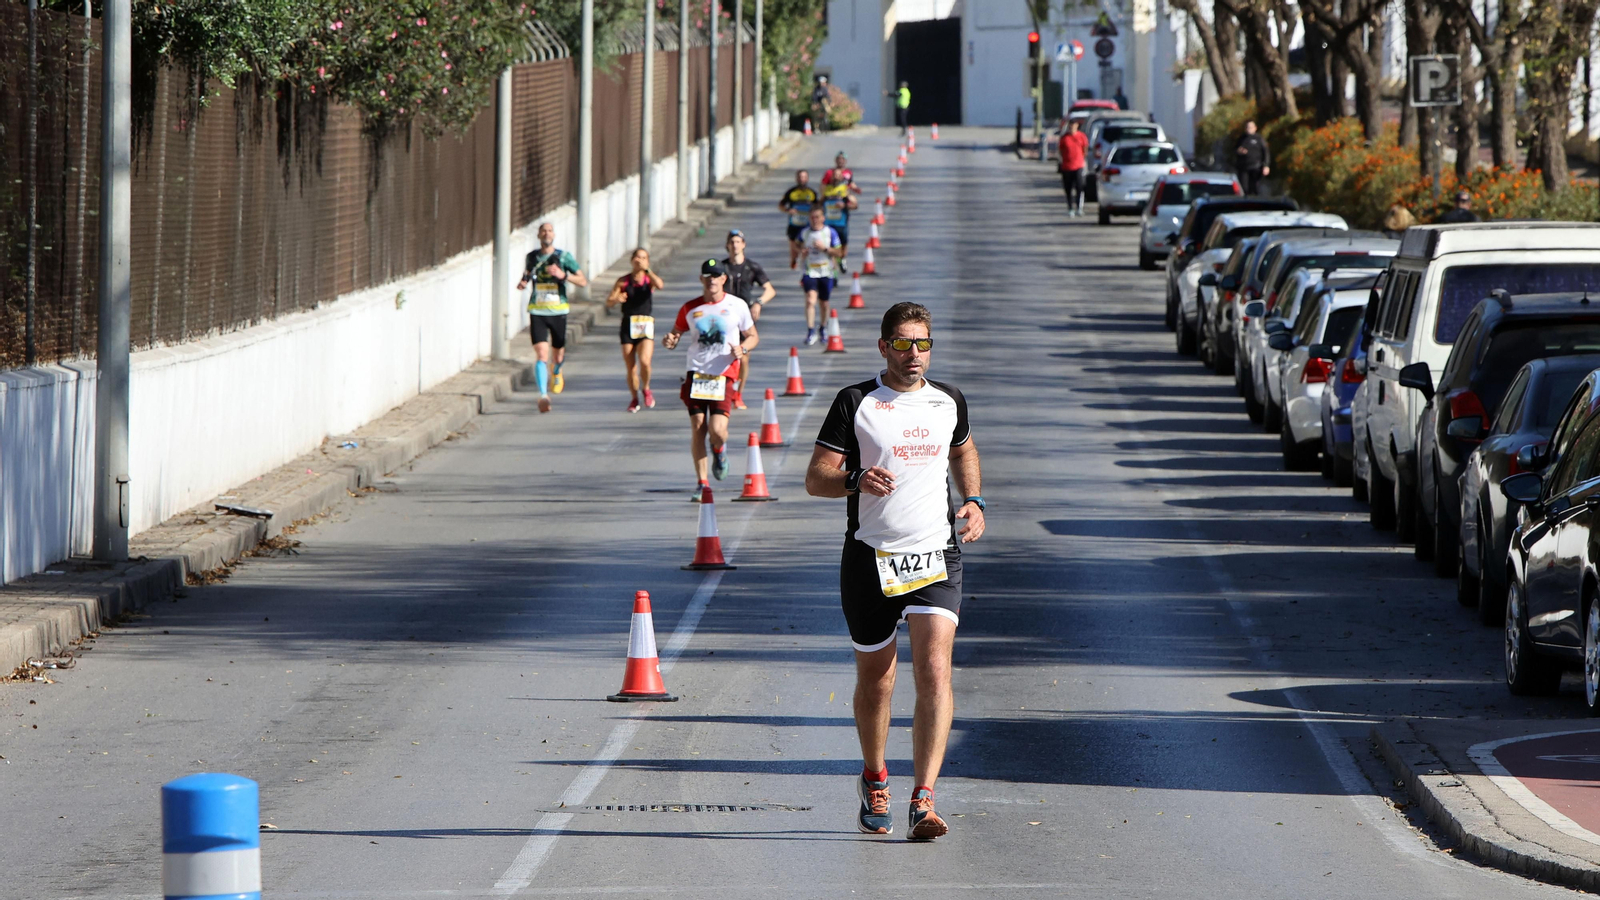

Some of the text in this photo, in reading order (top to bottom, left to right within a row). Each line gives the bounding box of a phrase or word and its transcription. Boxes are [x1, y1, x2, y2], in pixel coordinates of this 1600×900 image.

[1419, 61, 1450, 101] P
[903, 426, 930, 439] edp
[889, 552, 932, 577] 1427
